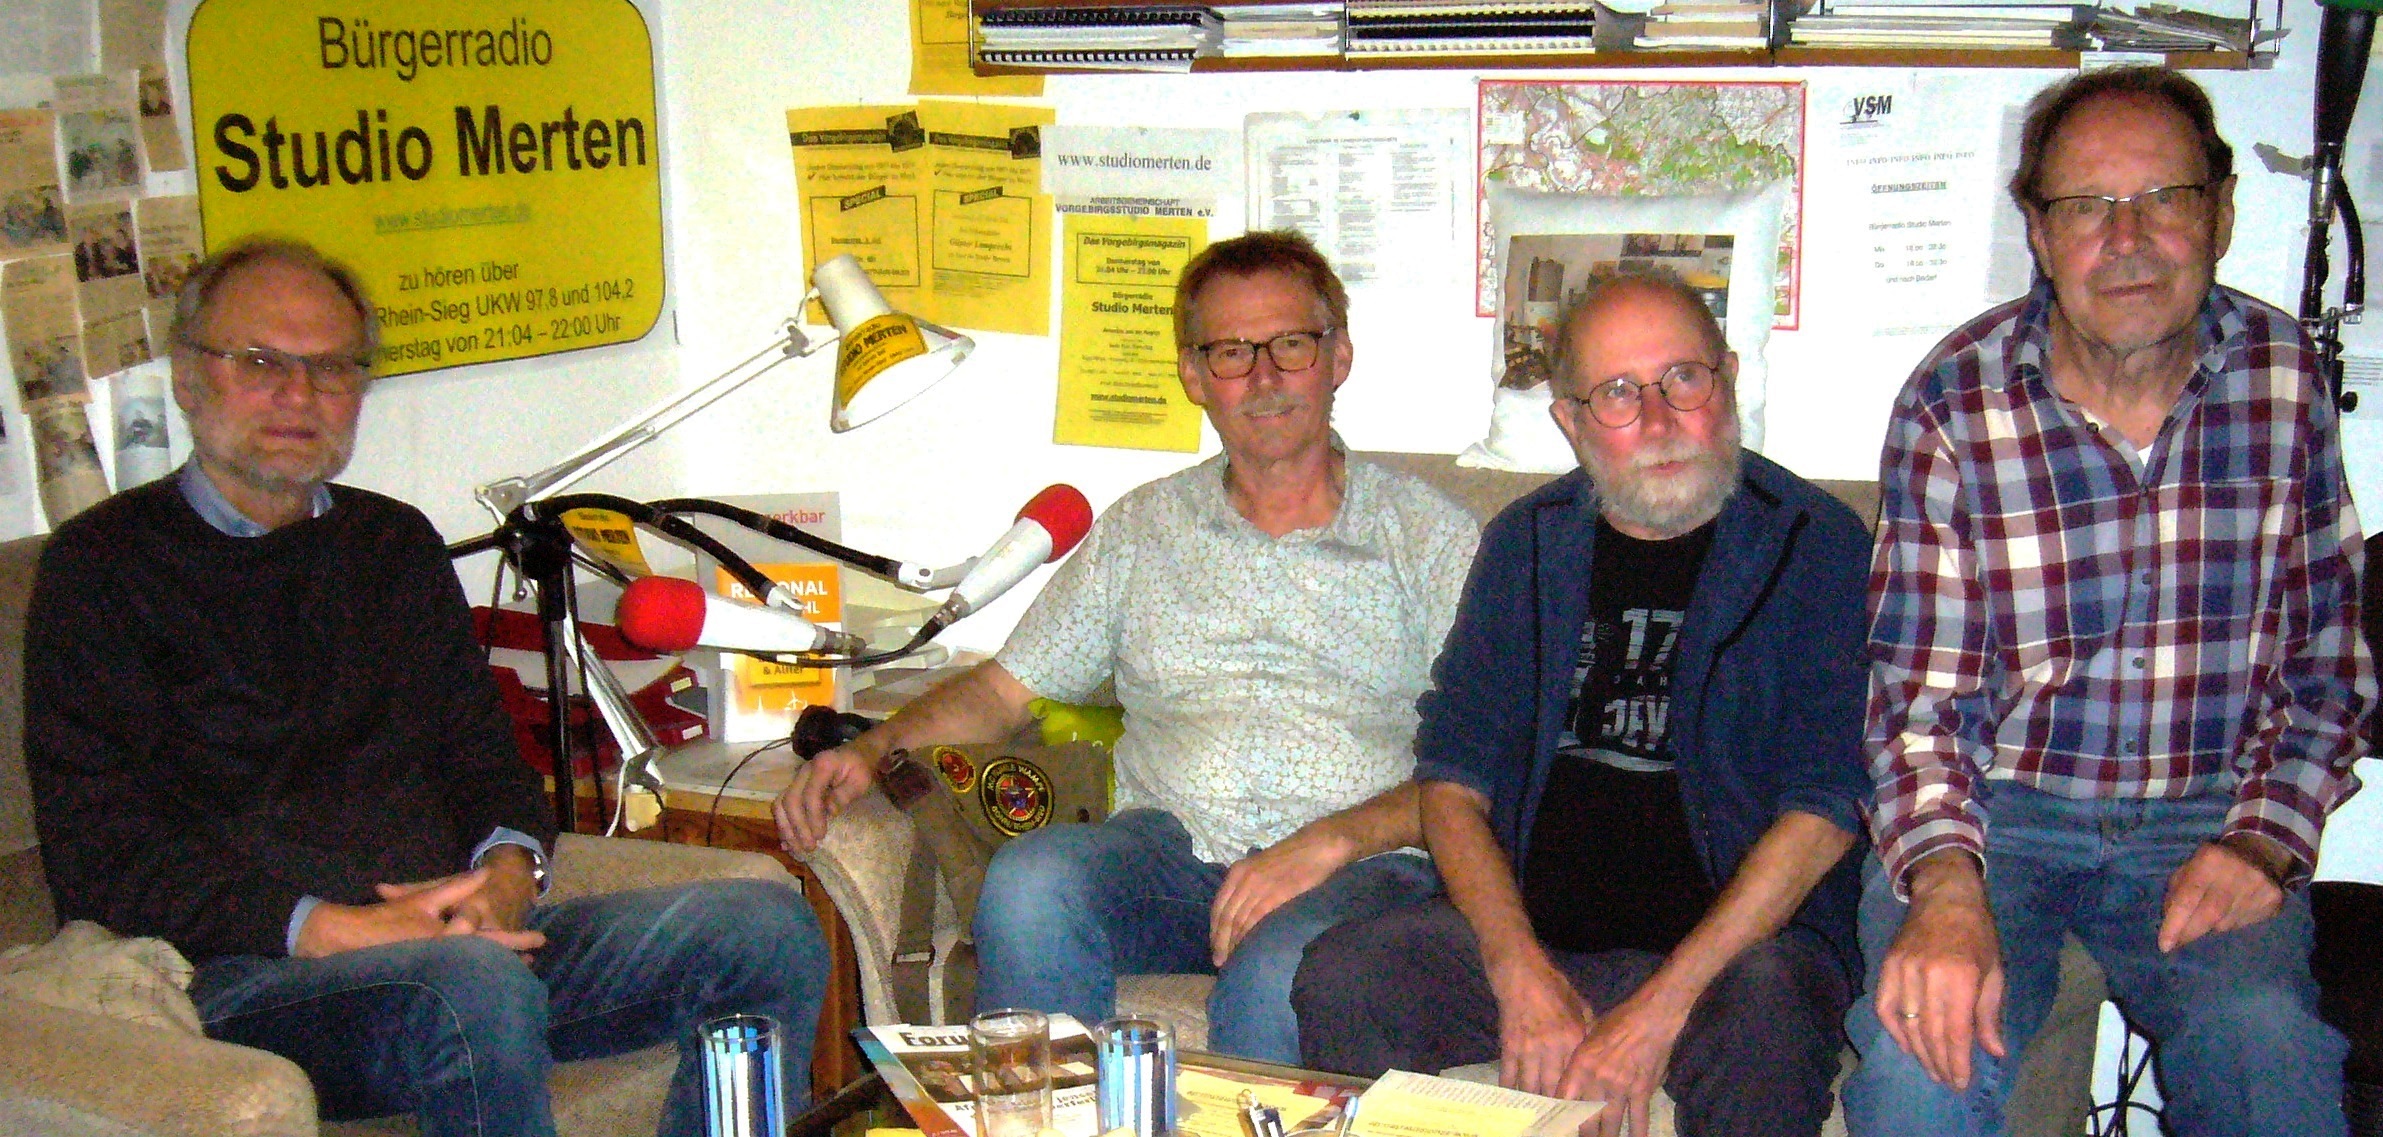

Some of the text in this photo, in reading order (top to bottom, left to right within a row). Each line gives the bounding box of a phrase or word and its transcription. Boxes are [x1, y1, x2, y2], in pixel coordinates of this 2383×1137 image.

[318, 16, 554, 82] Bürgerradio
[1853, 95, 1893, 117] VSM
[213, 104, 647, 193] Studio Merten
[1058, 153, 1212, 171] www.studiomerten.de
[1871, 181, 1947, 193] ÖFFNUNGSZEITEN
[1055, 203, 1214, 217] VORGEBIRGSSTUDIO MERTEN e.V.
[399, 261, 520, 292] zu hören über
[476, 290, 521, 317] UKW
[562, 283, 590, 307] und
[1091, 302, 1174, 315] Studio Merten
[446, 333, 478, 353] von
[595, 313, 622, 334] Uhr
